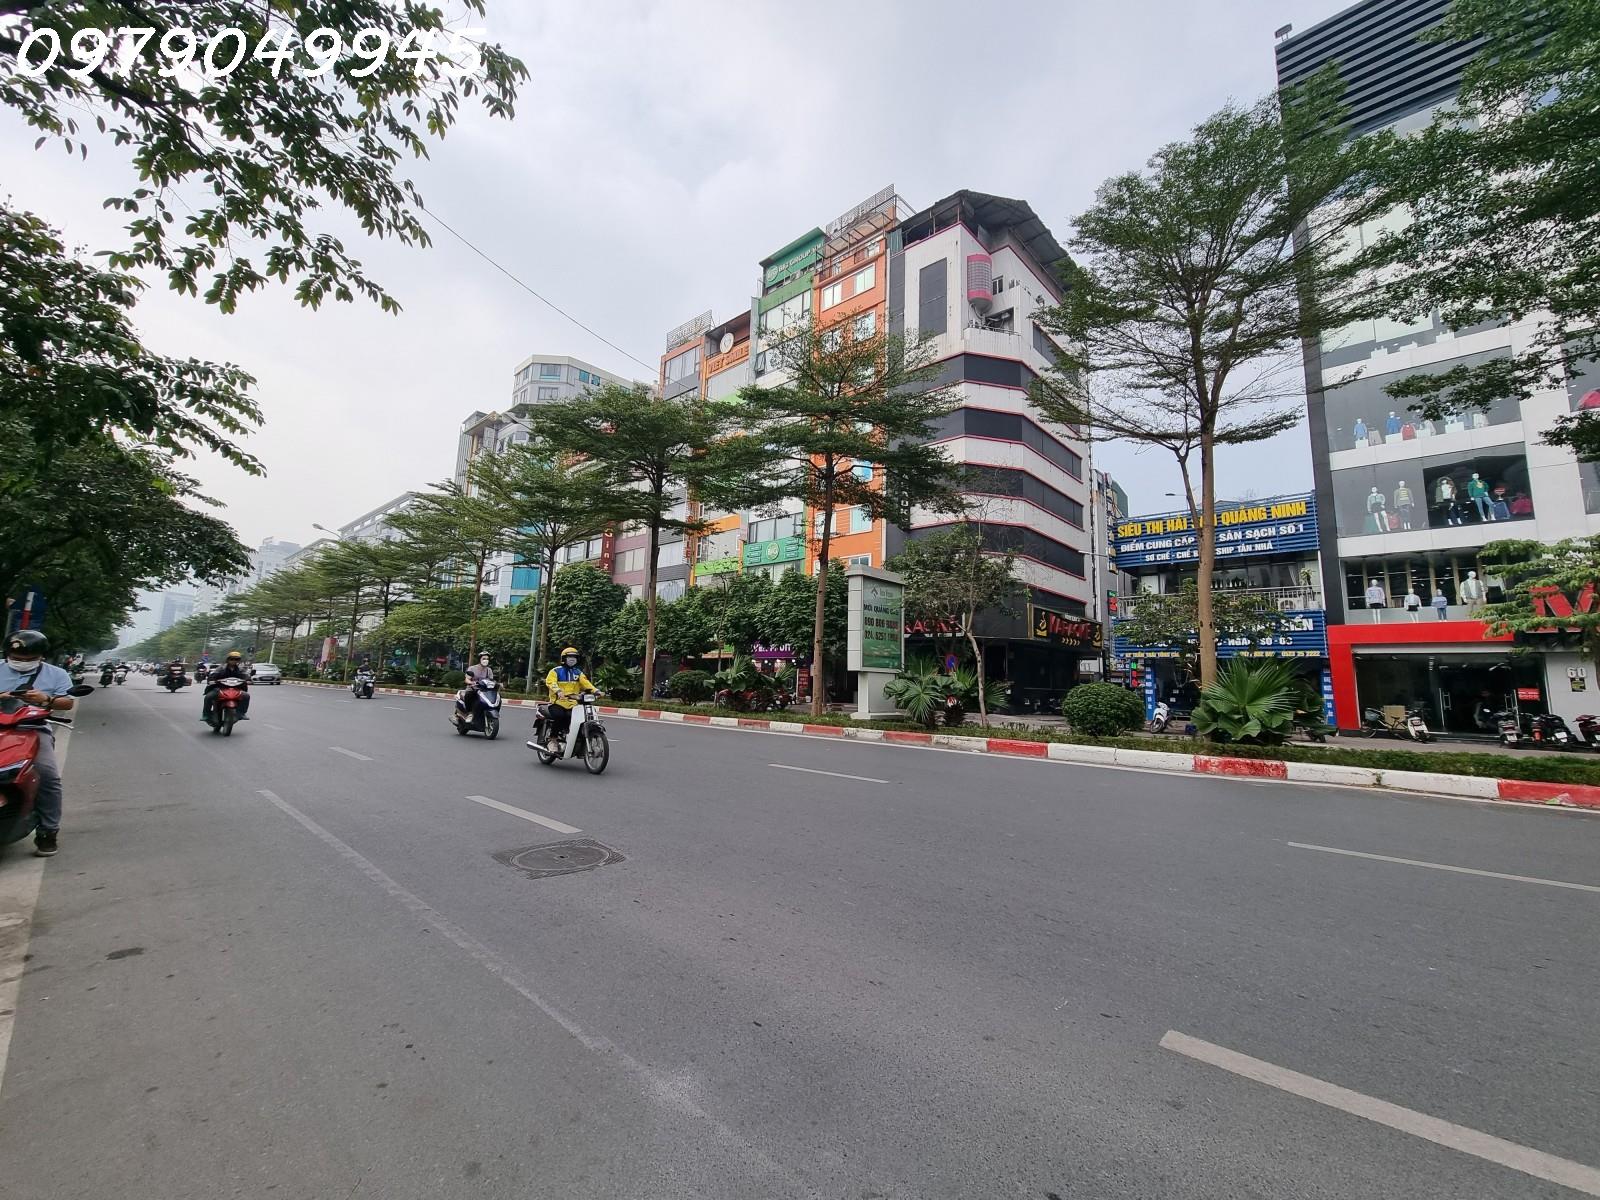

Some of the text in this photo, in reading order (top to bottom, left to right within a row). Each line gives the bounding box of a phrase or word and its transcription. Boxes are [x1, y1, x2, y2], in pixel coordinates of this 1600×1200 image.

[1145, 520, 1164, 535] THỊ
[1166, 513, 1187, 532] HẢI
[1221, 505, 1267, 526] QUẢNG
[1270, 501, 1306, 519] NINH
[1121, 522, 1304, 552] ĐIỂM CUNG CẤP SẢN SẠCH SỐ 1
[1215, 546, 1234, 555] SHIP
[1567, 667, 1587, 679] 60
